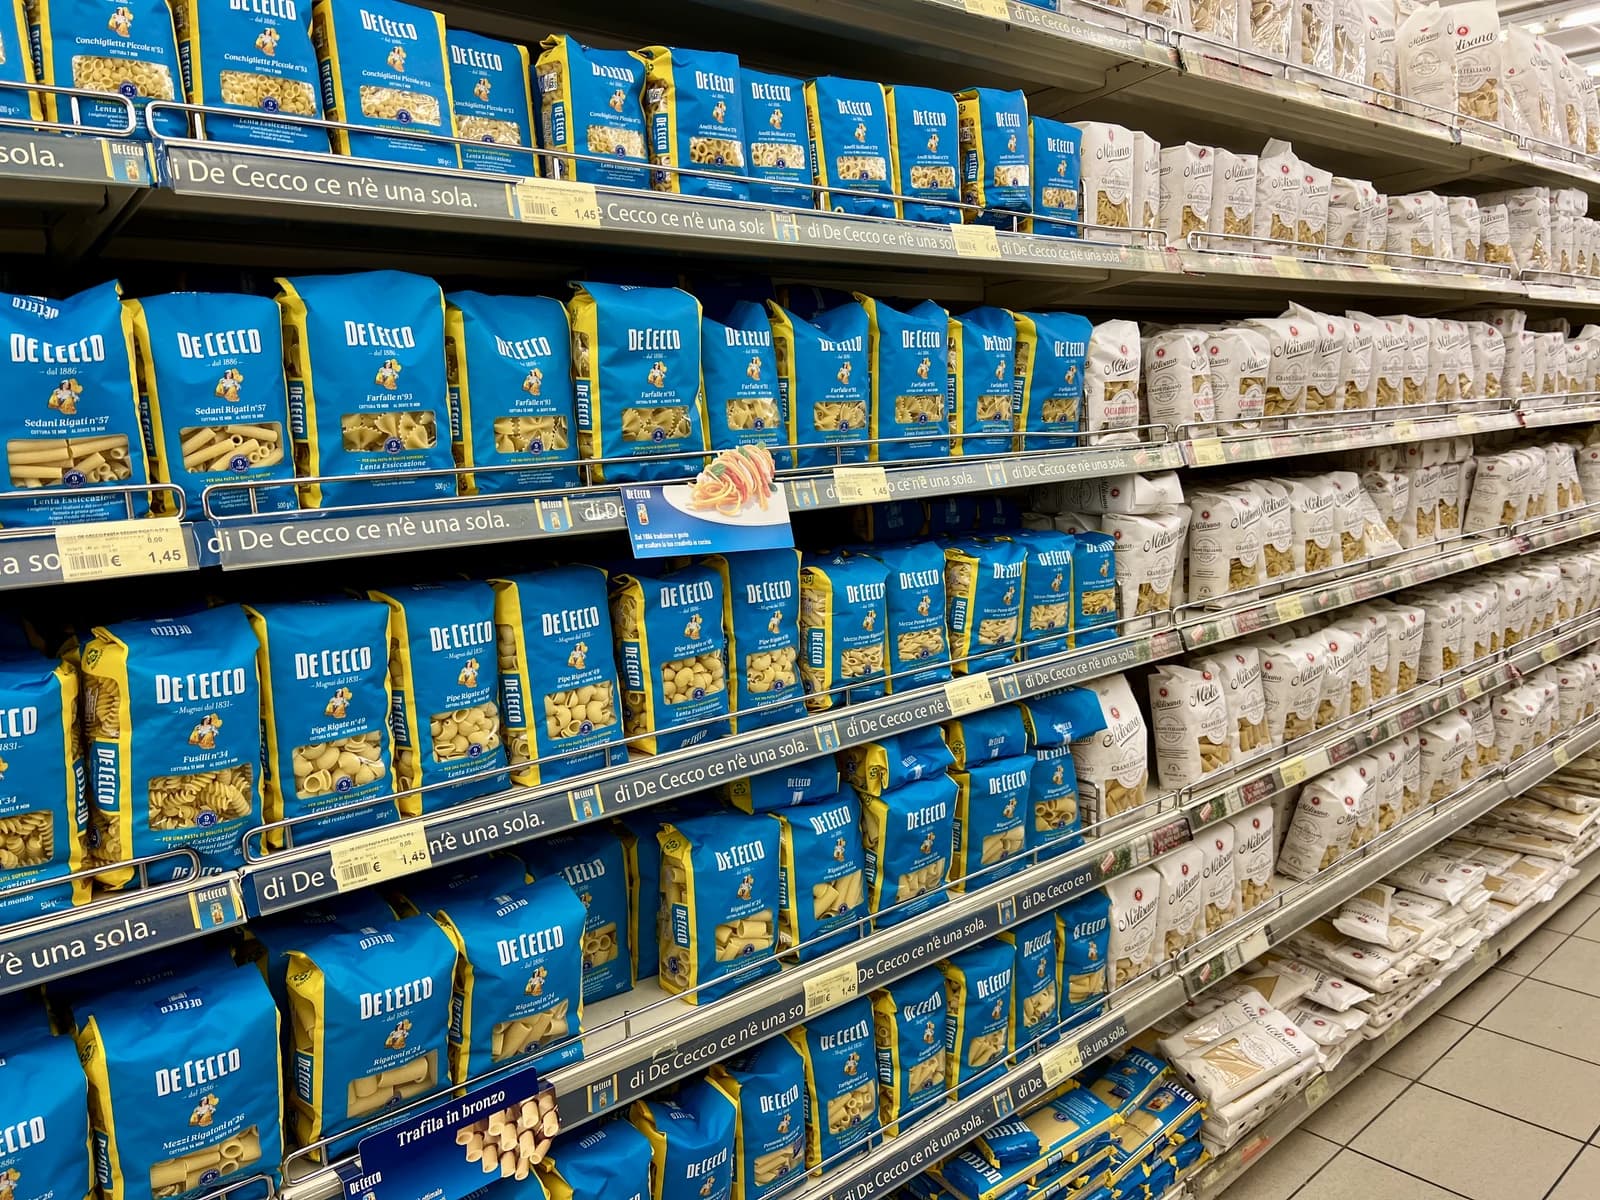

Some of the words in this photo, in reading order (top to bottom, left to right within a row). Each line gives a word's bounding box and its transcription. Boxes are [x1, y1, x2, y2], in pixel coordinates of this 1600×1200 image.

[187, 159, 226, 185] De
[232, 164, 309, 192] Cecco
[314, 177, 341, 196] ce
[385, 184, 425, 204] una
[431, 185, 478, 208] sola.
[574, 208, 597, 221] 1,45
[607, 203, 657, 226] Cecco
[661, 212, 678, 229] ce
[708, 217, 736, 234] una
[808, 222, 820, 239] di
[823, 225, 841, 241] De
[844, 225, 880, 246] Cecco
[882, 232, 896, 246] ce
[917, 235, 937, 249] una
[195, 406, 224, 416] Sedani
[225, 405, 250, 416] Rigati
[367, 393, 396, 402] Farfalle
[24, 418, 56, 428] Sedani
[57, 417, 88, 429] Rigati
[1038, 462, 1066, 476] Cecco
[1092, 459, 1108, 471] una
[898, 477, 912, 492] ce
[929, 474, 949, 488] una
[952, 472, 976, 486] sola.
[208, 527, 230, 554] di
[240, 531, 273, 549] De
[280, 525, 349, 547] Cecco
[356, 523, 381, 540] ce
[422, 516, 460, 535] una
[467, 509, 510, 530] sola.
[148, 550, 181, 564] 1,45
[1036, 671, 1049, 686] De
[1050, 665, 1076, 682] Cecco
[1102, 656, 1118, 668] una
[311, 725, 326, 735] Pipe
[327, 721, 349, 732] Rigate
[847, 718, 859, 738] di
[862, 718, 878, 735] De
[879, 710, 913, 731] Cecco
[915, 706, 927, 719] ce
[183, 753, 211, 763] Fusilli
[615, 786, 630, 804] di
[635, 781, 656, 799] De
[659, 769, 705, 791] Cecco
[708, 763, 724, 776] ce
[750, 750, 777, 767] una
[780, 738, 809, 758] sola.
[263, 880, 286, 901] di
[293, 871, 325, 892] De
[462, 824, 499, 847] una
[504, 811, 545, 834] sola.
[403, 852, 426, 865] 1,45
[32, 936, 86, 969] una
[94, 919, 157, 945] sola.
[859, 967, 875, 984] De
[877, 952, 910, 978] Cecco
[912, 944, 925, 958] ce
[943, 929, 963, 945] una
[964, 918, 987, 937] sola.
[630, 1069, 645, 1089] di
[650, 1062, 670, 1081] De
[674, 1041, 717, 1069] Cecco
[720, 1034, 736, 1048] ce
[761, 1015, 786, 1032] una
[1092, 1037, 1109, 1052] una
[373, 1052, 403, 1067] Rigatoni
[397, 1117, 443, 1148] Trafila
[446, 1111, 460, 1127] in
[462, 1090, 506, 1120] bronzo
[163, 1136, 189, 1150] Mezzi
[190, 1119, 226, 1141] Rigatoni
[875, 1161, 909, 1188] Cecco
[911, 1153, 923, 1167] ce
[941, 1132, 961, 1148] una
[962, 1114, 985, 1137] sola.
